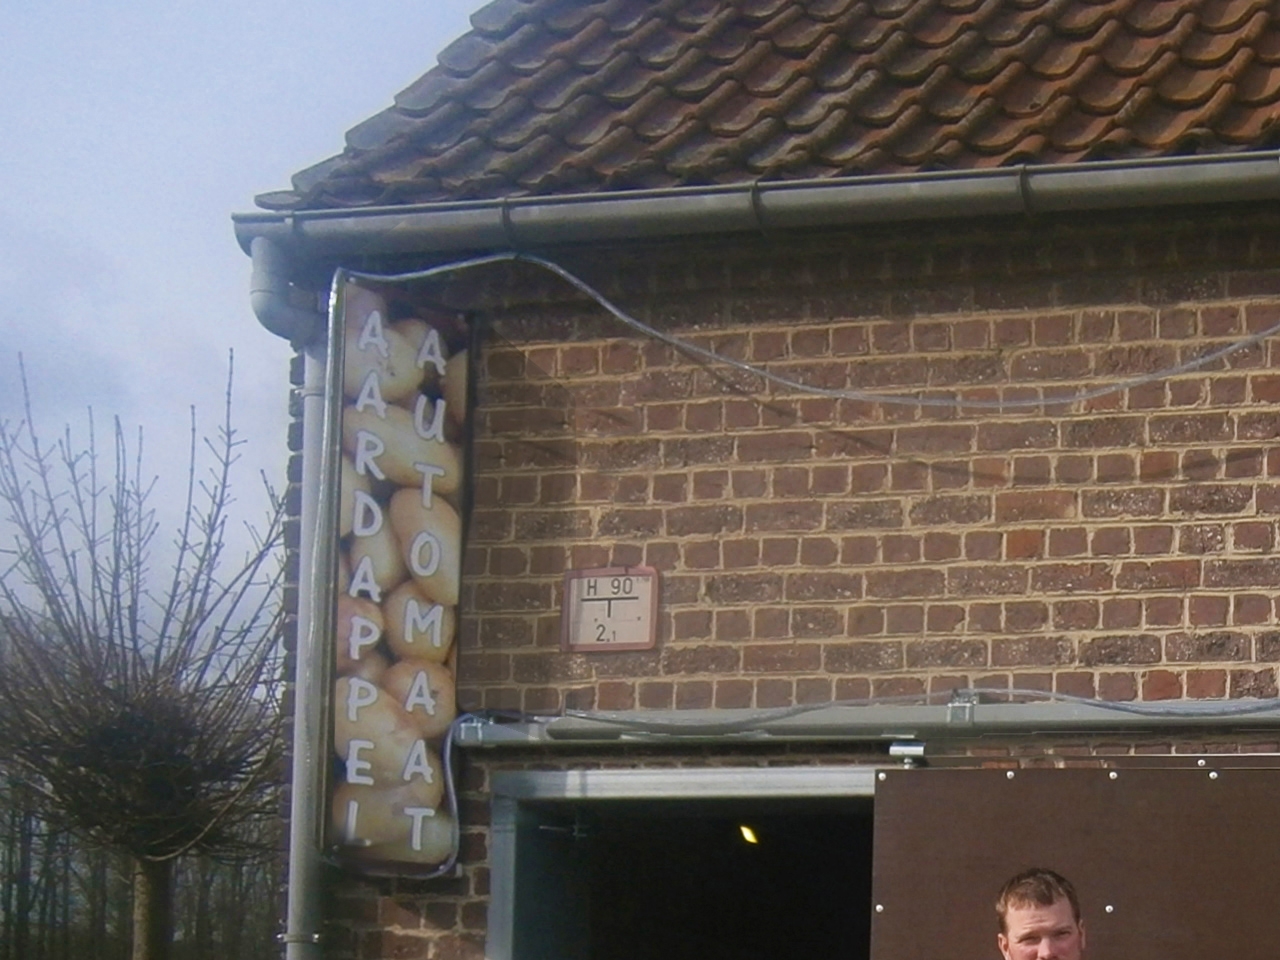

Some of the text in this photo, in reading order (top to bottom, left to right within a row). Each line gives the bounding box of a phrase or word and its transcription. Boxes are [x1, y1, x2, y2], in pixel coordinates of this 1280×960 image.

[403, 329, 446, 851] AUTOMAAT
[586, 577, 633, 596] H 90
